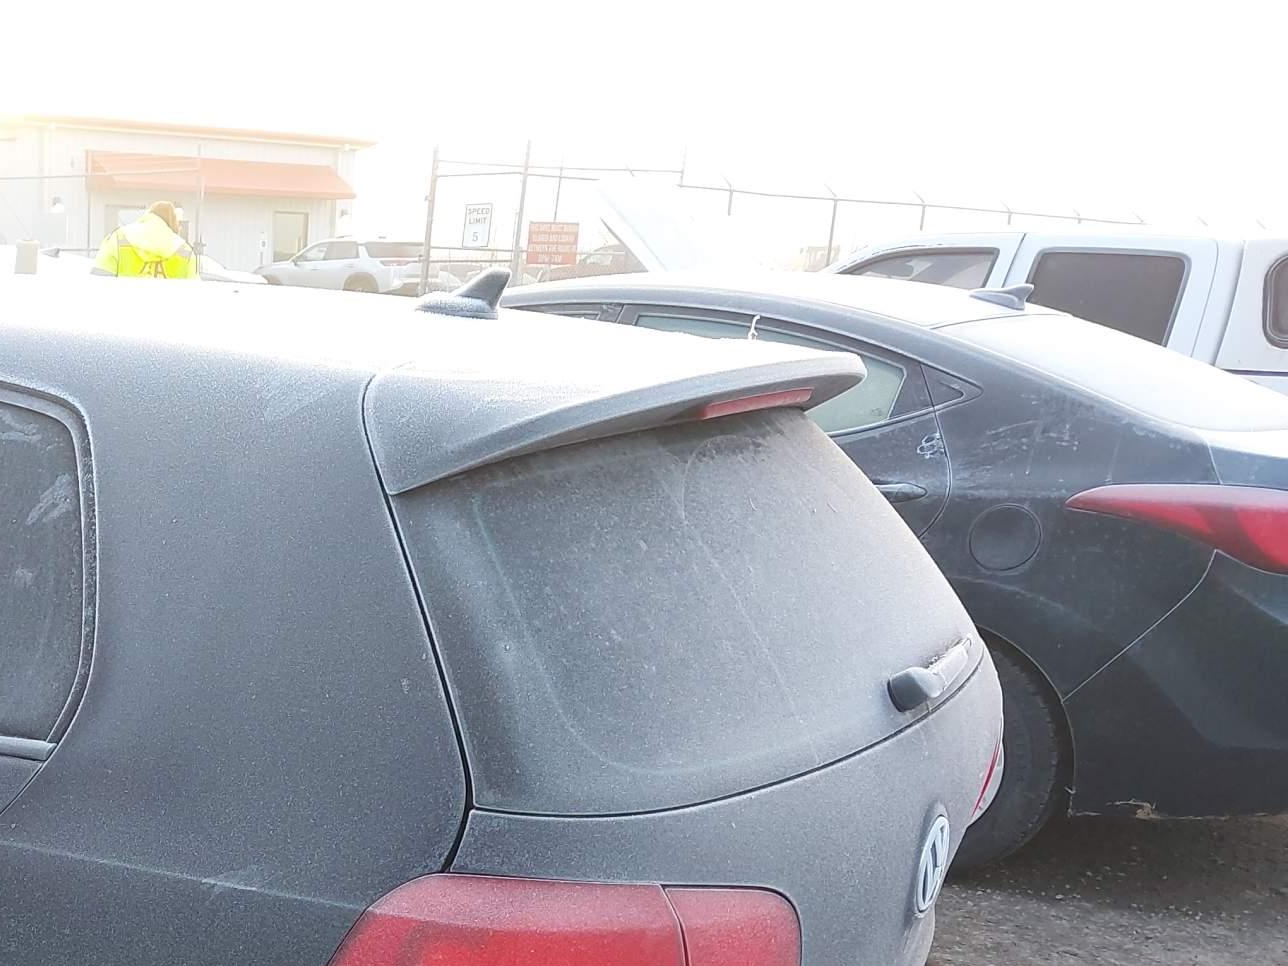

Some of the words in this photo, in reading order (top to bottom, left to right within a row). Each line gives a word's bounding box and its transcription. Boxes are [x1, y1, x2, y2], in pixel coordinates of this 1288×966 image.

[467, 207, 490, 215] SPEED
[468, 216, 487, 225] LIMIT
[471, 231, 479, 242] 5
